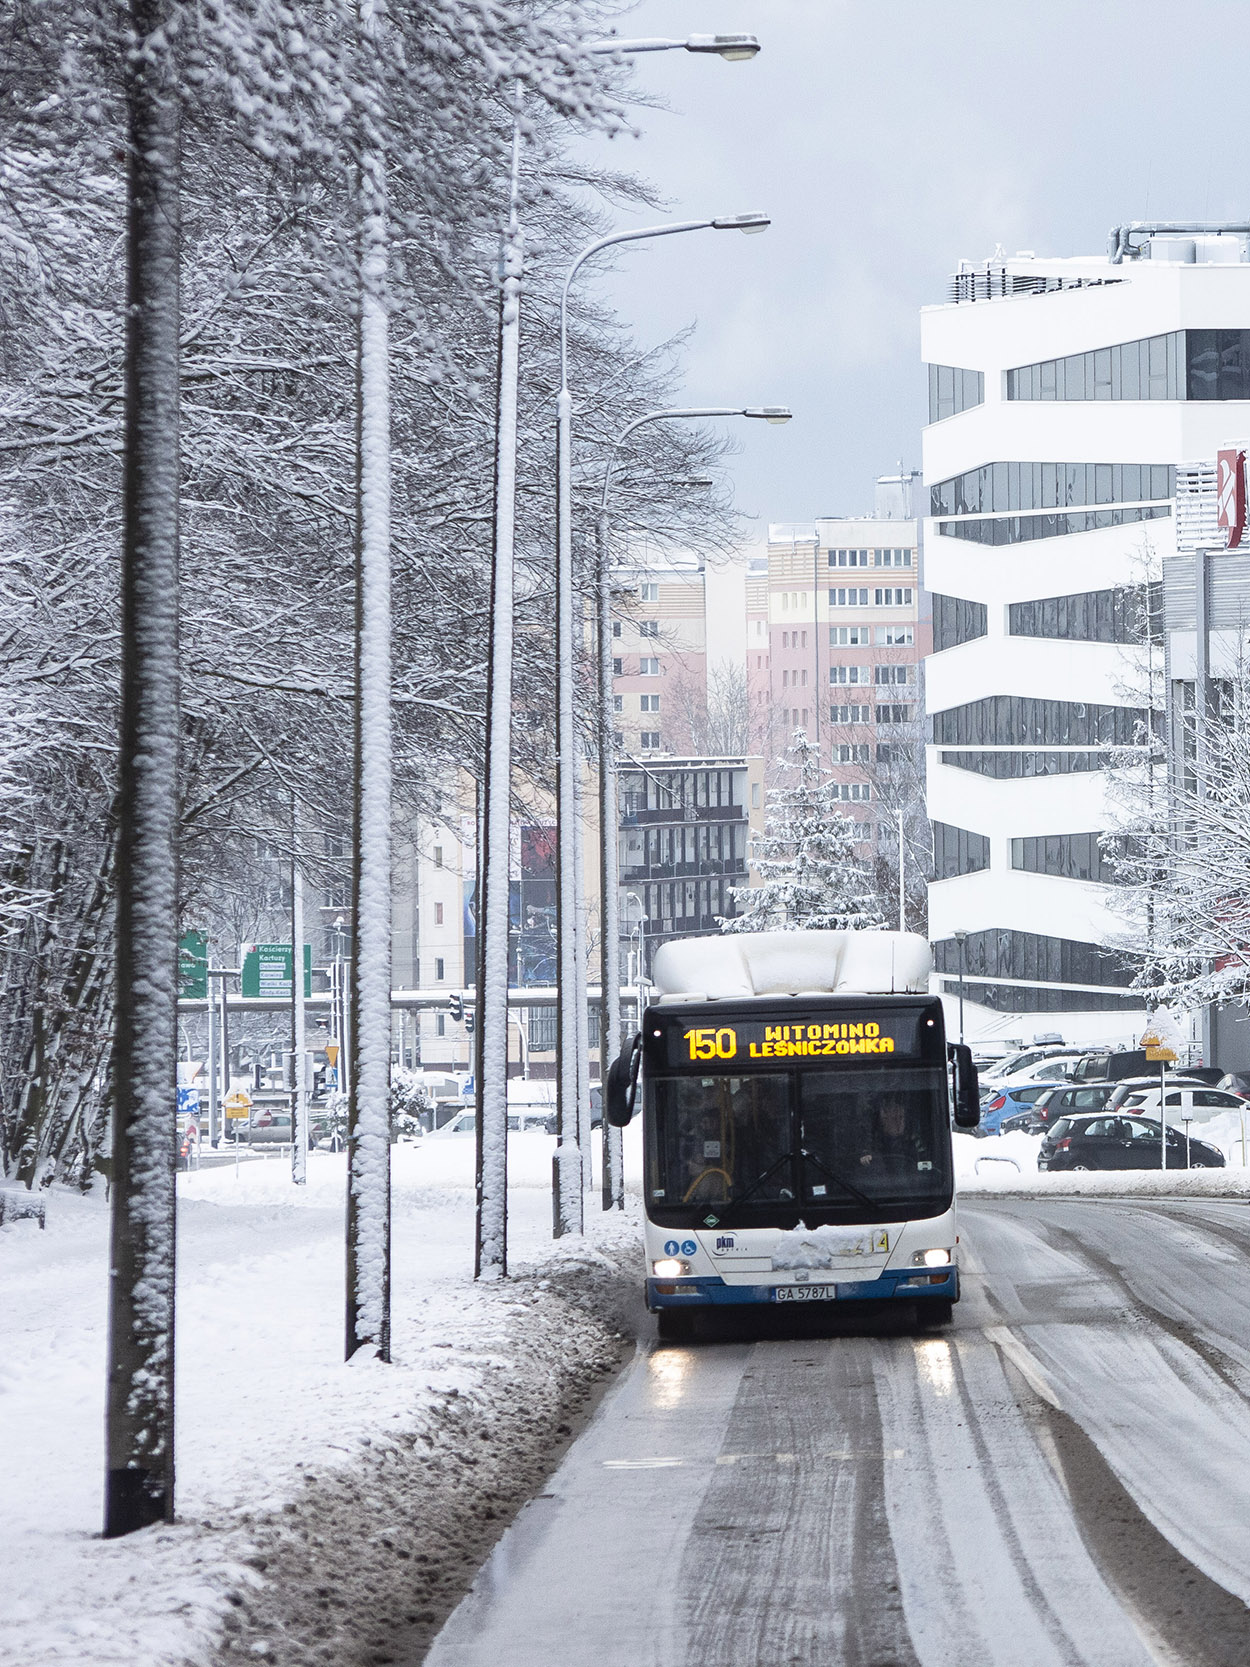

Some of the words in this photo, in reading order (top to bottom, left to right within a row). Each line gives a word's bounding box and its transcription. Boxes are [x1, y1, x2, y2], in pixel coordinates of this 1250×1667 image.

[259, 946, 292, 954] Kościerzy
[765, 1022, 880, 1041] WITOMINO
[684, 1028, 737, 1060] 150
[716, 1236, 734, 1250] pkm
[777, 1288, 794, 1300] GA
[798, 1287, 833, 1299] 5787L
